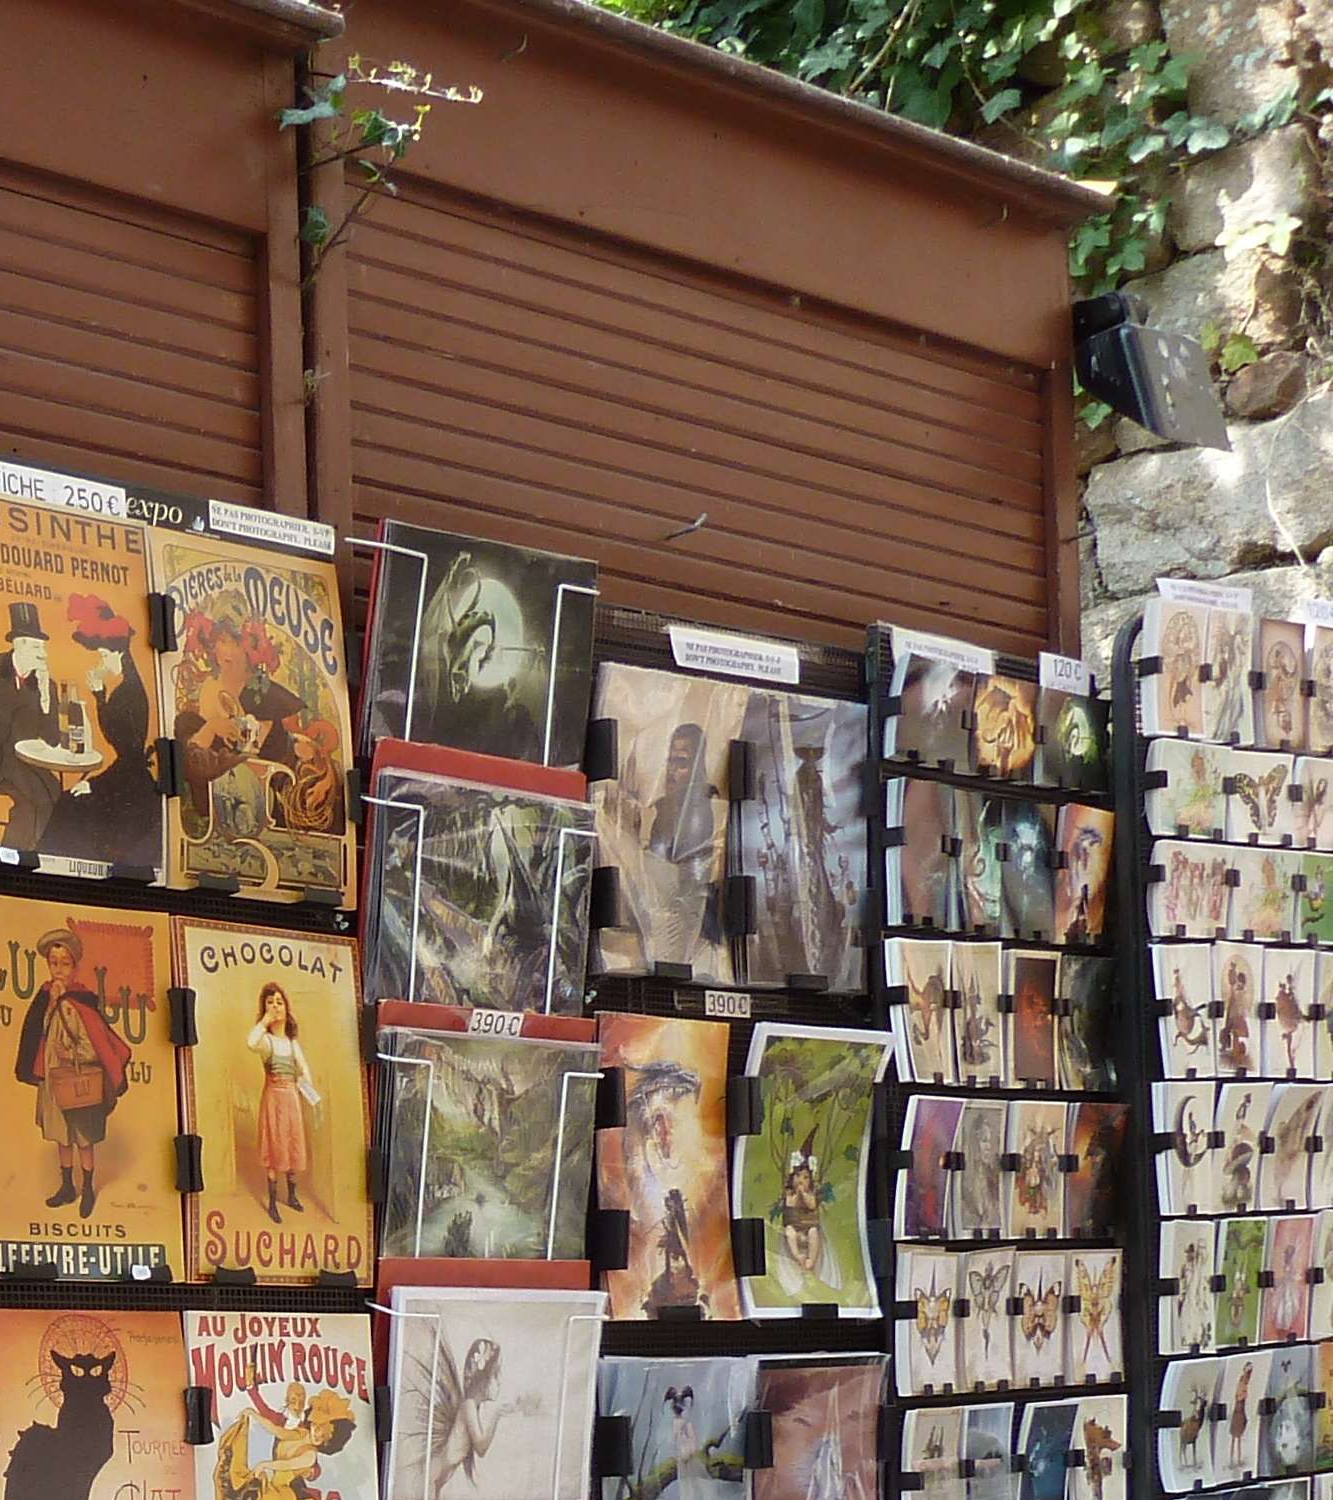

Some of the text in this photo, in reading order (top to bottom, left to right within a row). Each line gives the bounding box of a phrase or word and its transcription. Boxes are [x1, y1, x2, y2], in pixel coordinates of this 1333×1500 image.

[70, 556, 130, 587] PERNOT
[243, 567, 339, 677] MEUSE
[199, 942, 344, 985] CHOCOLAT
[92, 964, 150, 1045] LU
[129, 1063, 152, 1086] LU
[29, 1222, 127, 1239] BISCUITS
[204, 1209, 363, 1270] SUCHARD
[197, 1316, 226, 1339] AU
[233, 1314, 322, 1345] JOYEUX
[191, 1340, 372, 1430] MOULIN ROUGE
